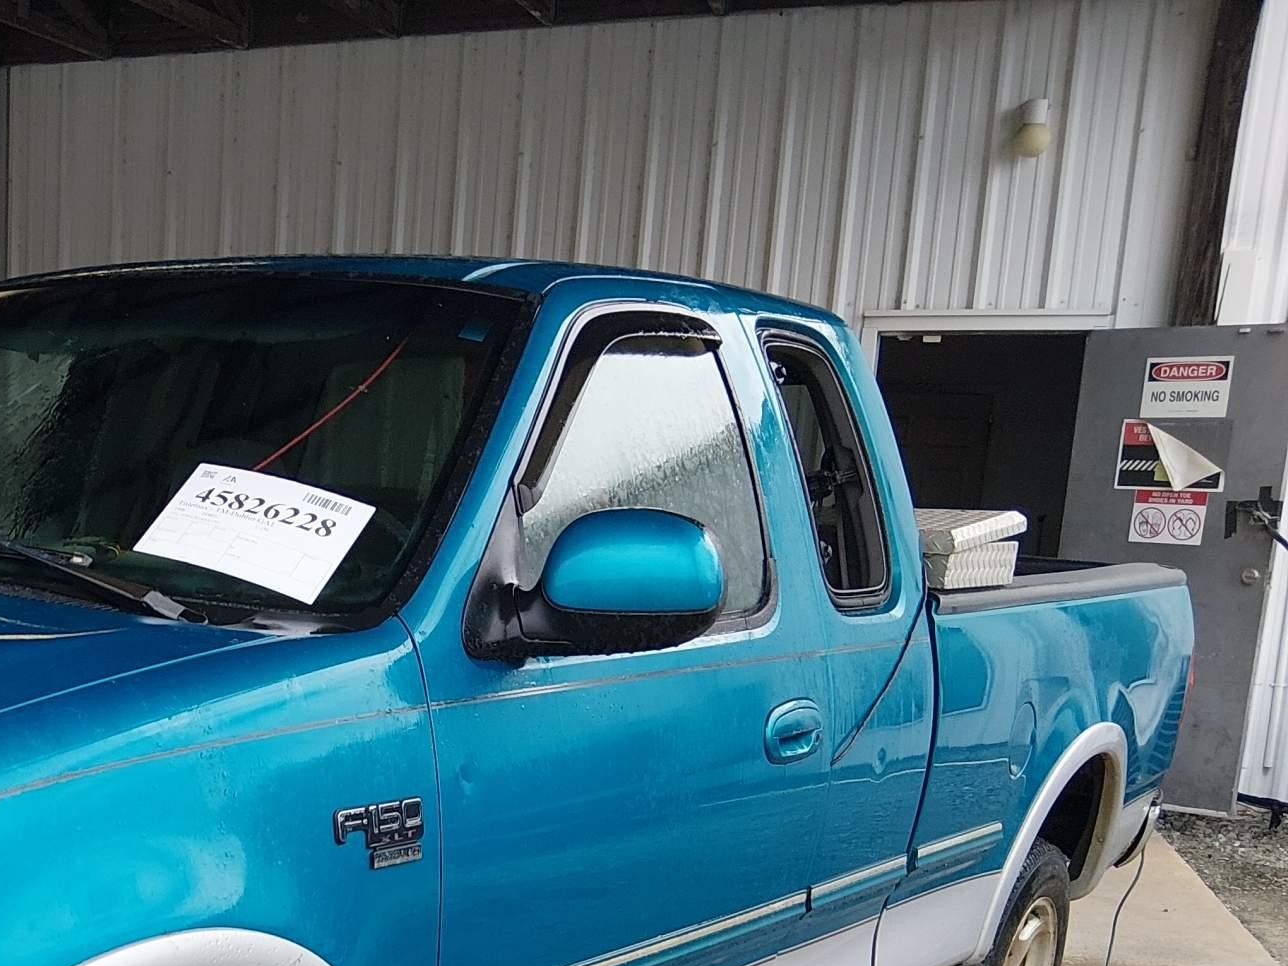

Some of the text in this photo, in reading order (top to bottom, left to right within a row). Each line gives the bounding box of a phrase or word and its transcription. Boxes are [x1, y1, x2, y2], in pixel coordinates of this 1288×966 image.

[1160, 365, 1217, 377] DANGER
[1150, 390, 1220, 402] NO SMOKING
[195, 487, 337, 538] 45826228
[380, 829, 417, 843] XLT
